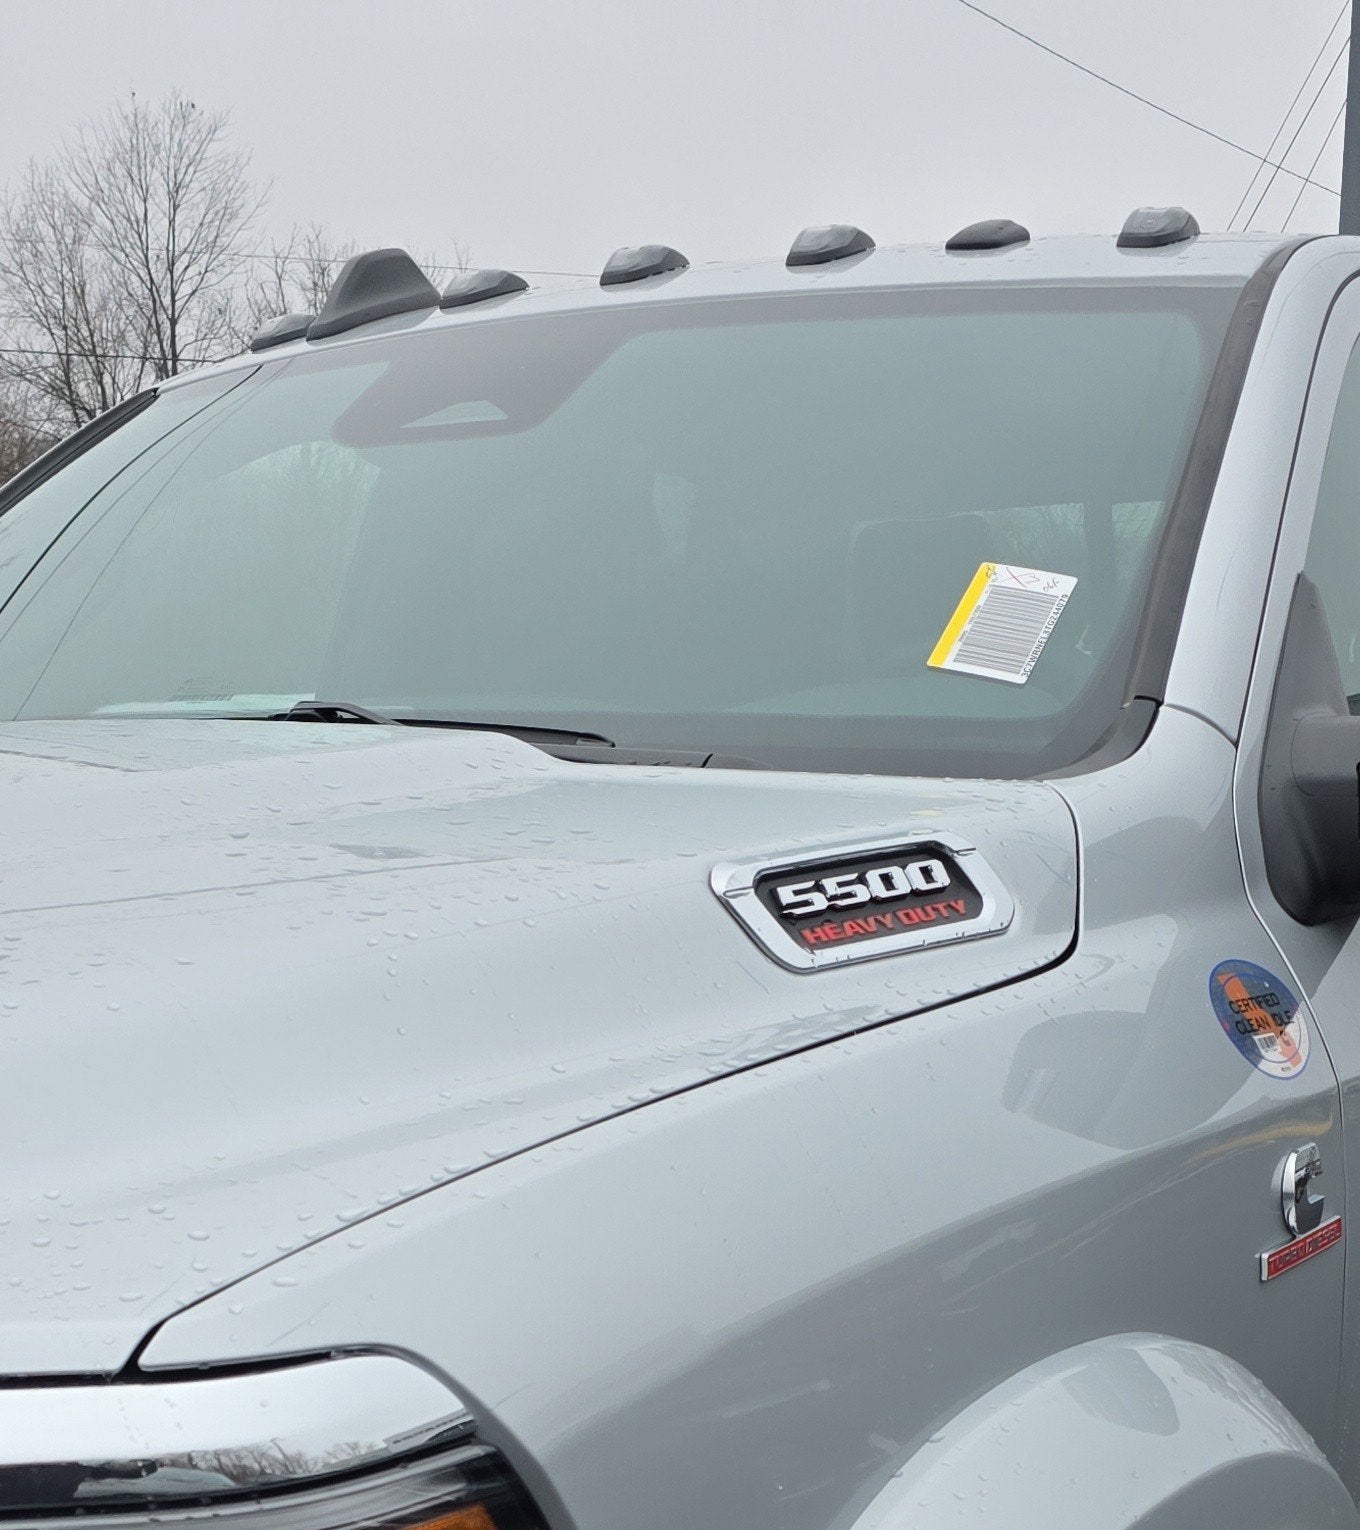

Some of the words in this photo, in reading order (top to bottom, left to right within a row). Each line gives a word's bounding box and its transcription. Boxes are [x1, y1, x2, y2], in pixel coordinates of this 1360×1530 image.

[774, 859, 952, 919] 5500
[801, 912, 895, 945] HEAVY
[898, 900, 968, 926] DUTY
[1229, 992, 1280, 1015] CERTIFIED
[1235, 1015, 1272, 1035] CLEAN
